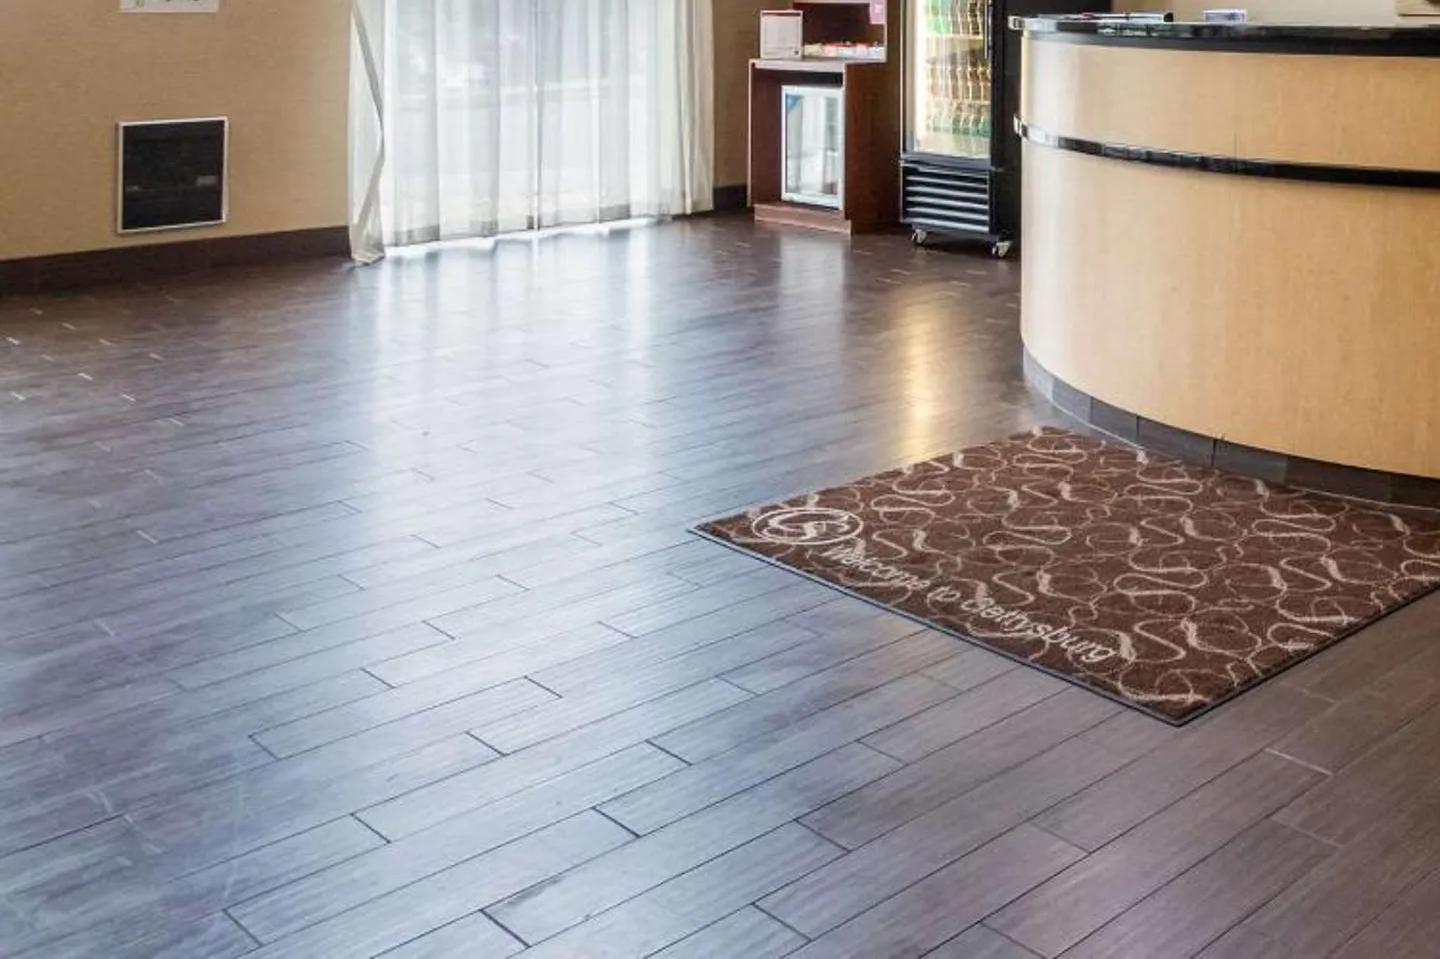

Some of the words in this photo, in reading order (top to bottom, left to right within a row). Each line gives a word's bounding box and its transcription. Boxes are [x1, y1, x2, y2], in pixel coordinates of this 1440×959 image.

[821, 544, 930, 589] Welcome
[934, 585, 961, 603] to
[961, 596, 1116, 663] Gettysburg
